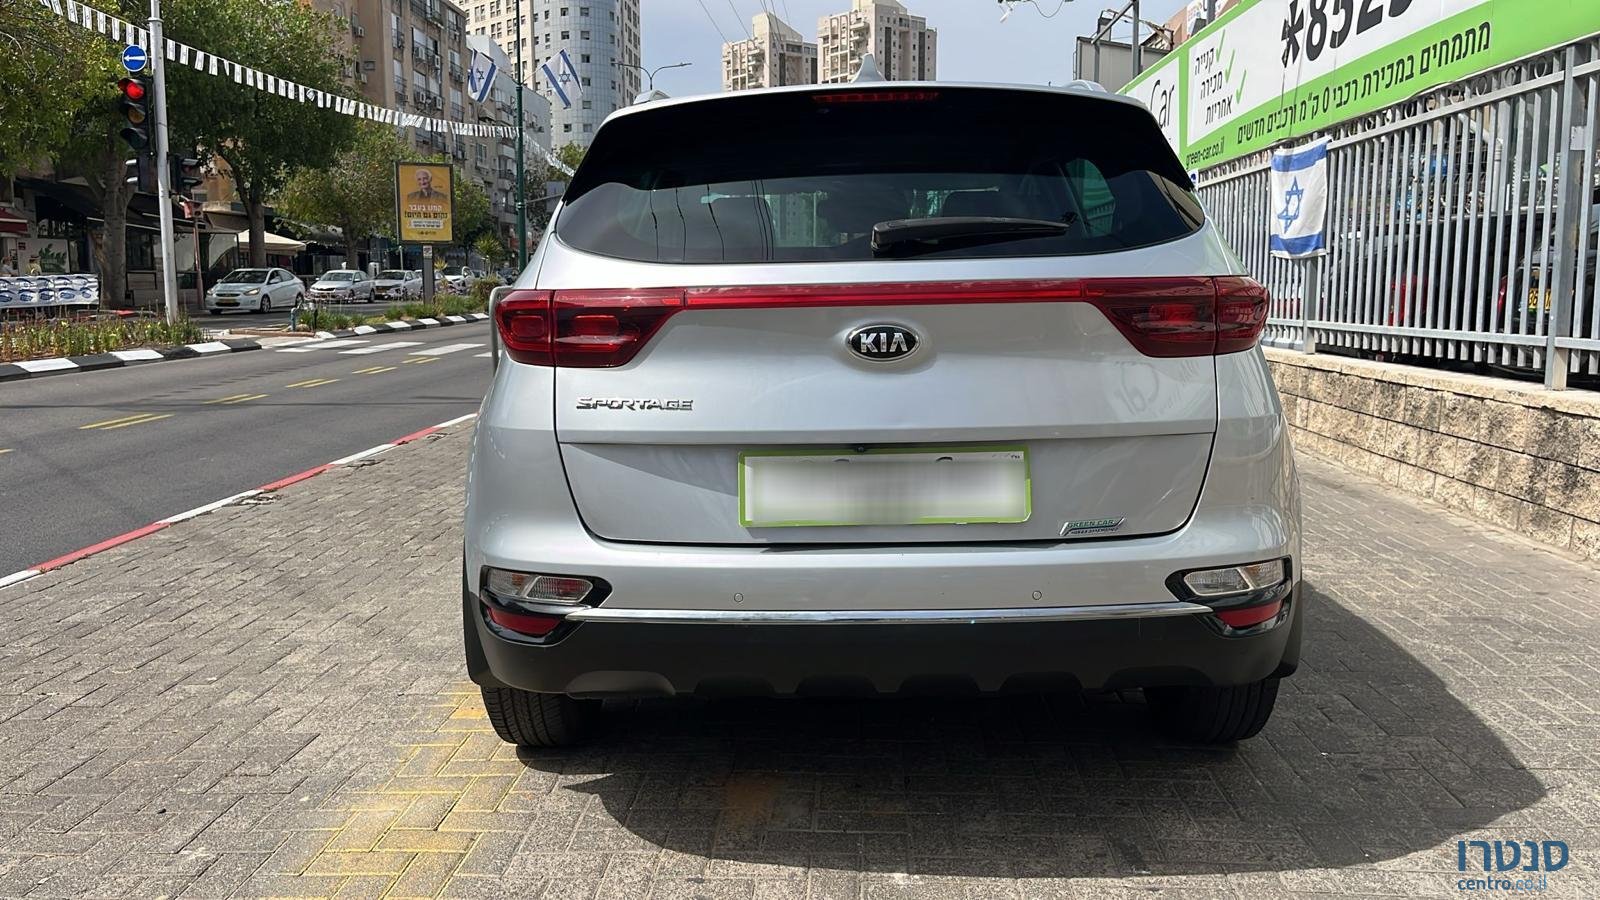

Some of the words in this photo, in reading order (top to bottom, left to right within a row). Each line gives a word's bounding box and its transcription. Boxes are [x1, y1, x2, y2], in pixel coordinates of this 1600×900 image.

[1281, 0, 1412, 68] 852
[1419, 21, 1491, 75] מתמחים
[1194, 47, 1214, 75] קנייה
[1200, 71, 1223, 99] מכירה
[1361, 54, 1415, 98] במכירת
[1299, 92, 1319, 122] ק"מ
[1322, 86, 1330, 113] 0
[1333, 79, 1358, 109] רכבי
[1205, 94, 1233, 125] אחריות
[1266, 104, 1297, 133] ורכבים
[1237, 117, 1265, 144] חדשים
[1185, 136, 1225, 170] green-car.co.il
[860, 332, 908, 353] KIA
[576, 398, 693, 411] SPORTAGE
